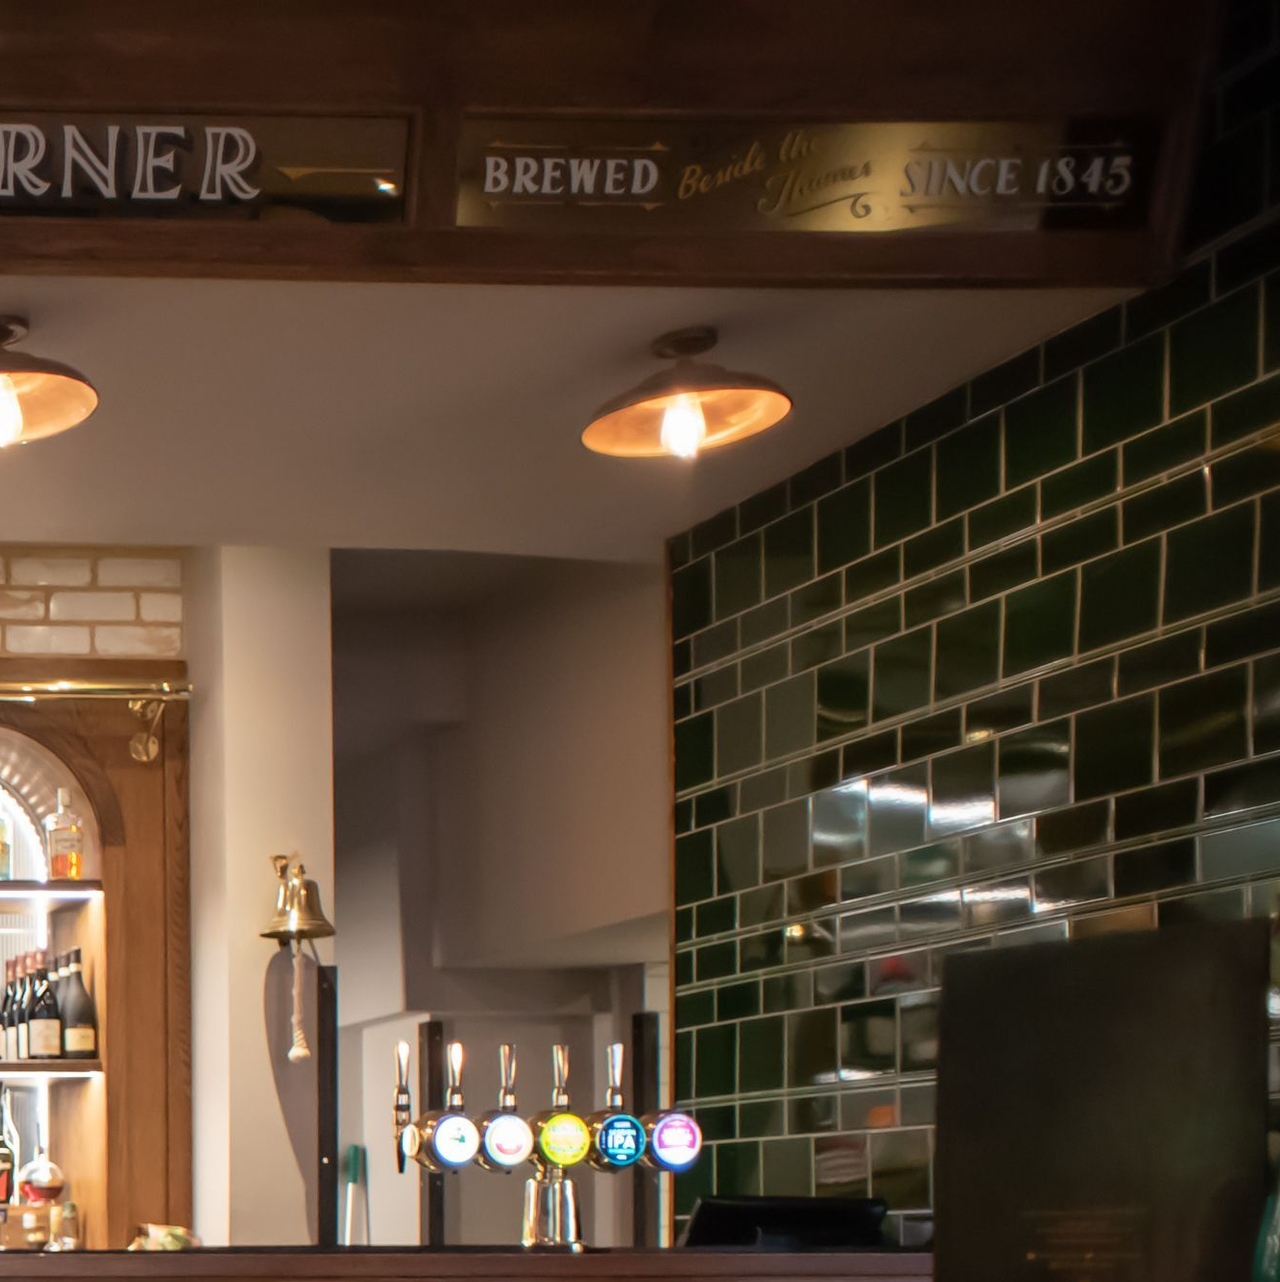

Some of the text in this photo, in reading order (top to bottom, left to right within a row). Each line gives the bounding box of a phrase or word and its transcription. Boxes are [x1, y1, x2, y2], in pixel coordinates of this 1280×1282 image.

[483, 155, 659, 196] BREWED
[900, 154, 1133, 196] SINCE 1845
